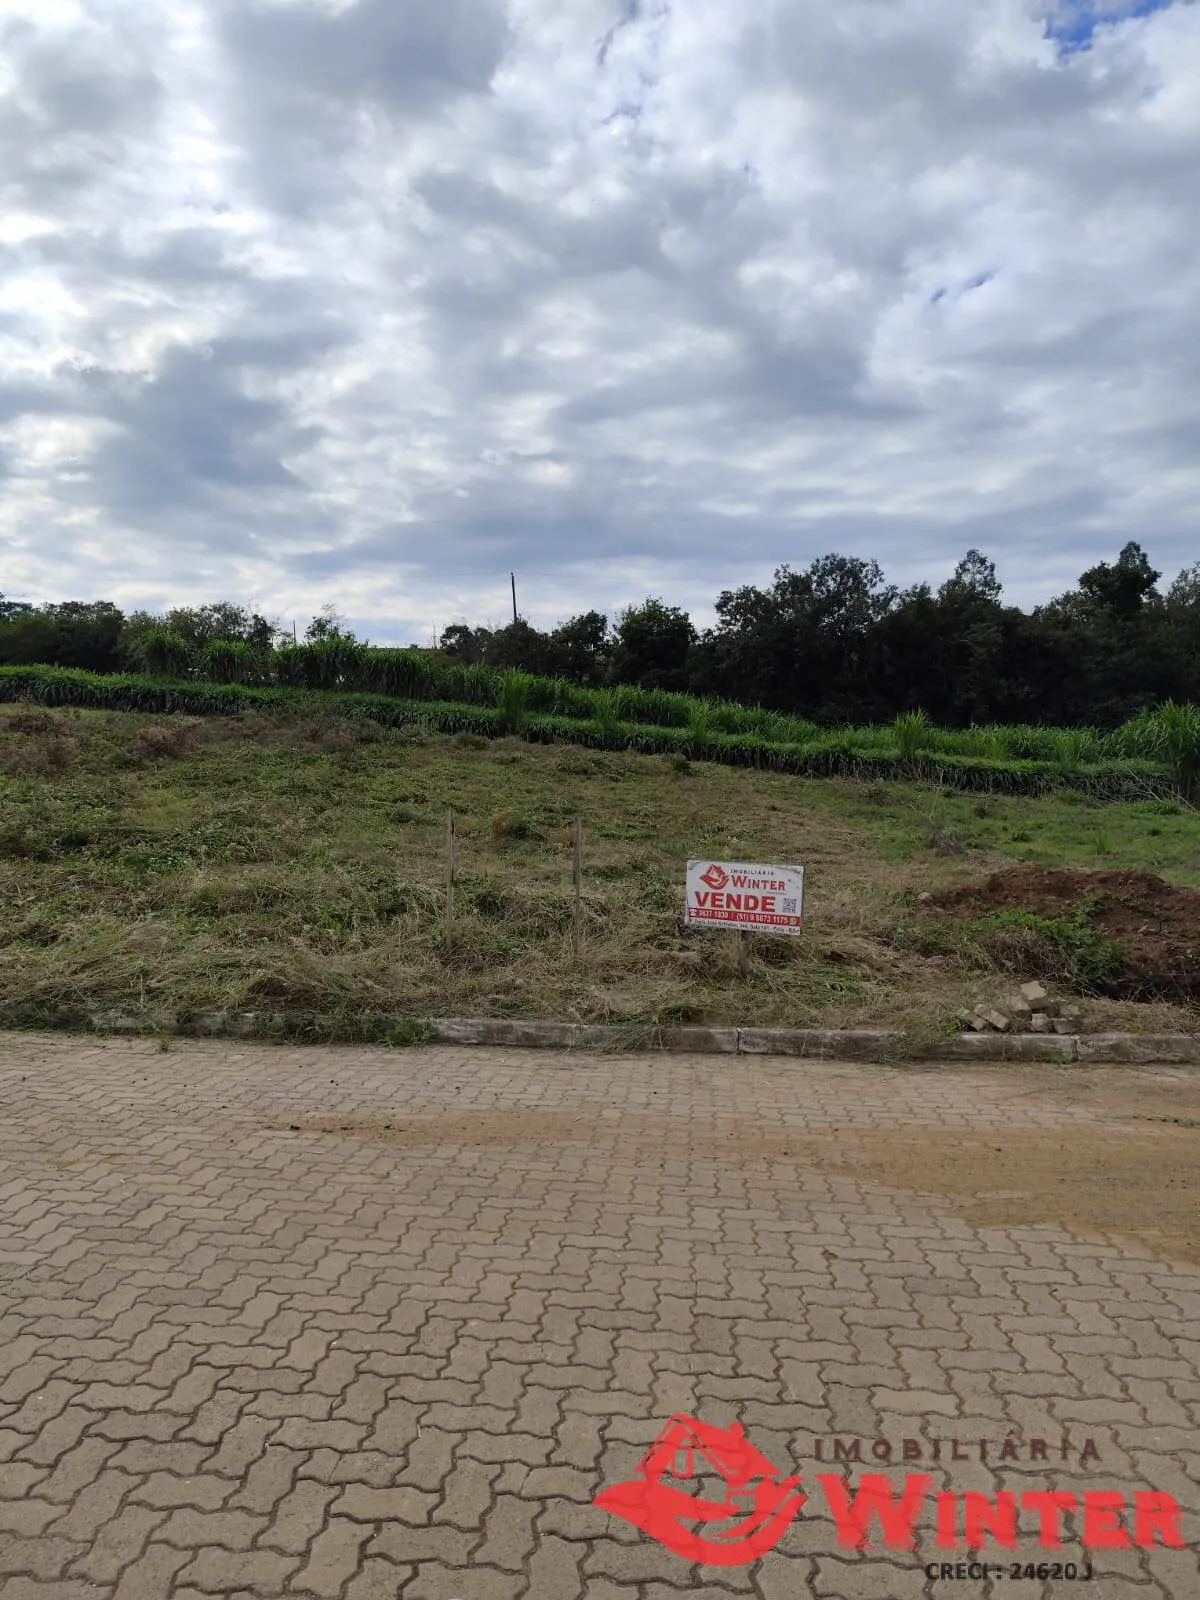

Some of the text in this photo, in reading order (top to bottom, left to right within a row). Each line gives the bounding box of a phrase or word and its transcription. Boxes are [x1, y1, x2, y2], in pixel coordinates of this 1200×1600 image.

[732, 875, 785, 890] WINTER
[695, 892, 776, 912] VENDE
[736, 913, 749, 921] (51)
